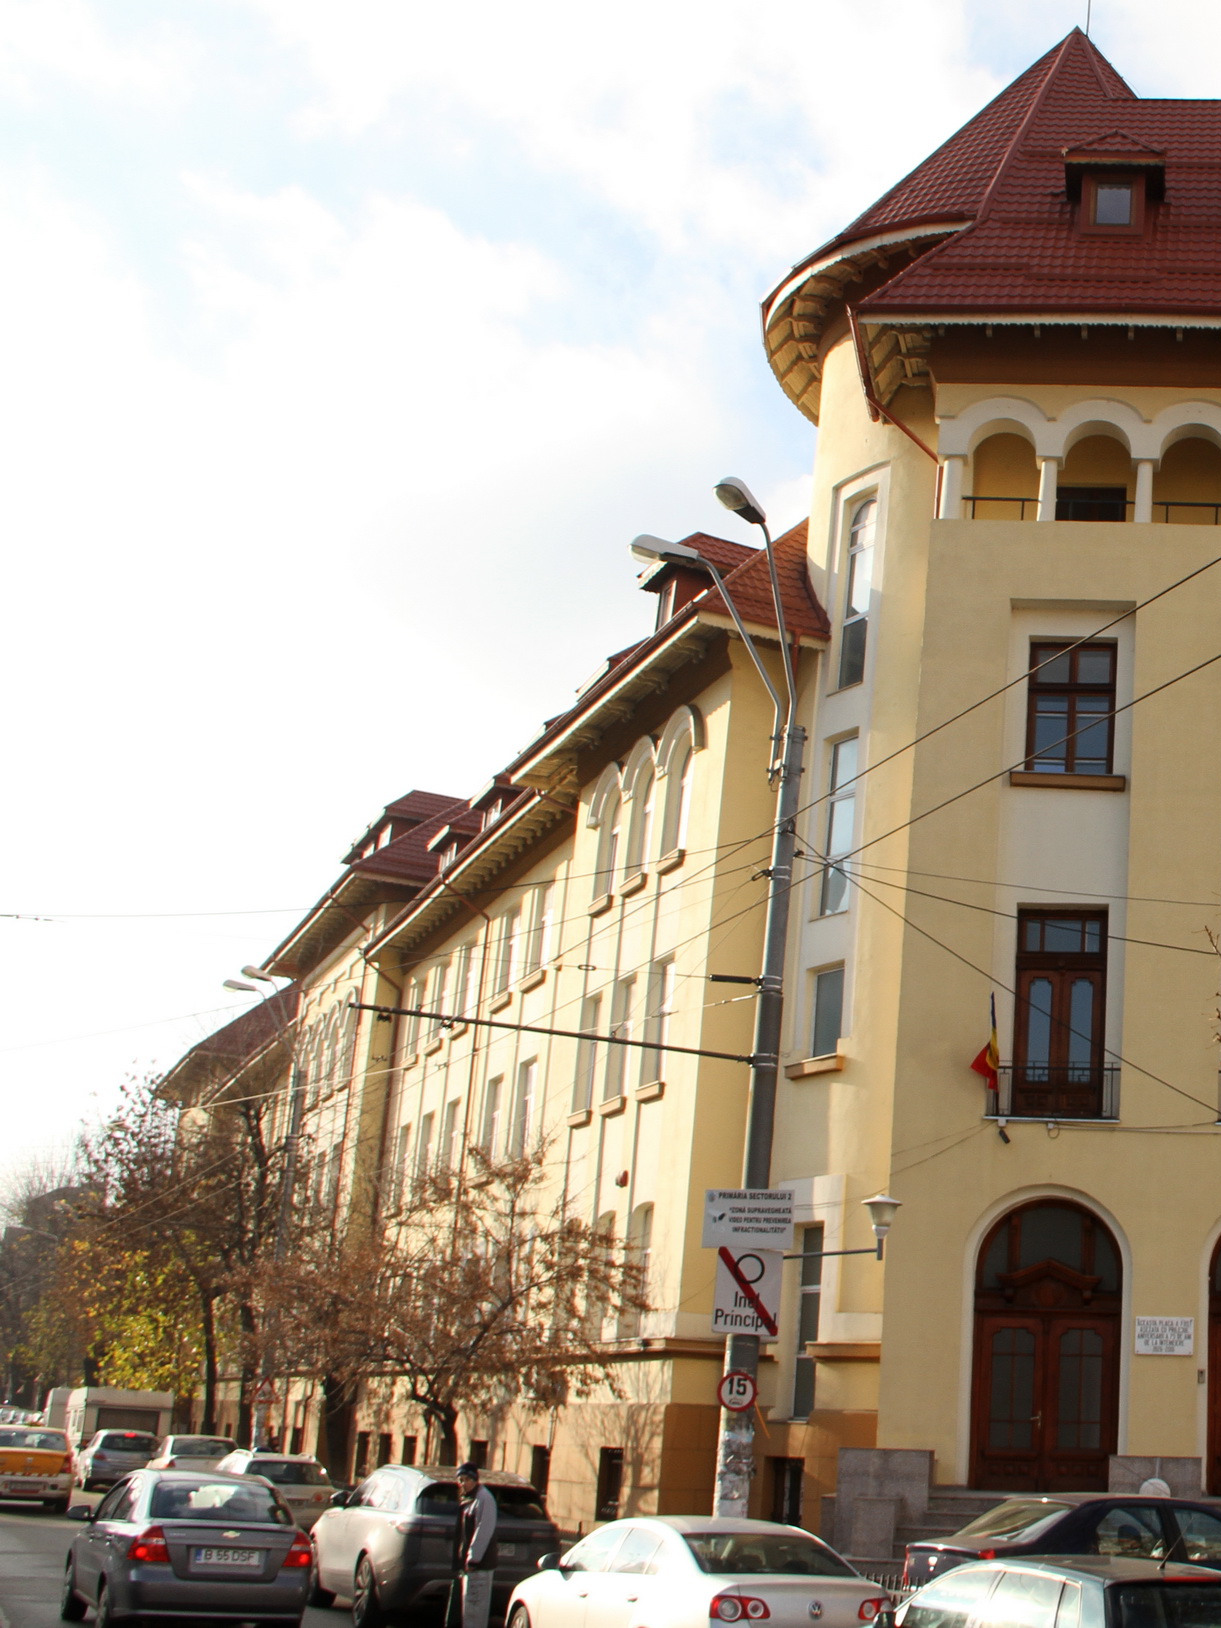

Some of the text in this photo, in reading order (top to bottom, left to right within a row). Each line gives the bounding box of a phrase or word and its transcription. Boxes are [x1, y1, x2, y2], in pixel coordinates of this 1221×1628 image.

[749, 1192, 786, 1200] SECTORULUI
[728, 1377, 747, 1395] 15
[204, 1549, 213, 1560] B
[231, 1551, 255, 1562] DSF
